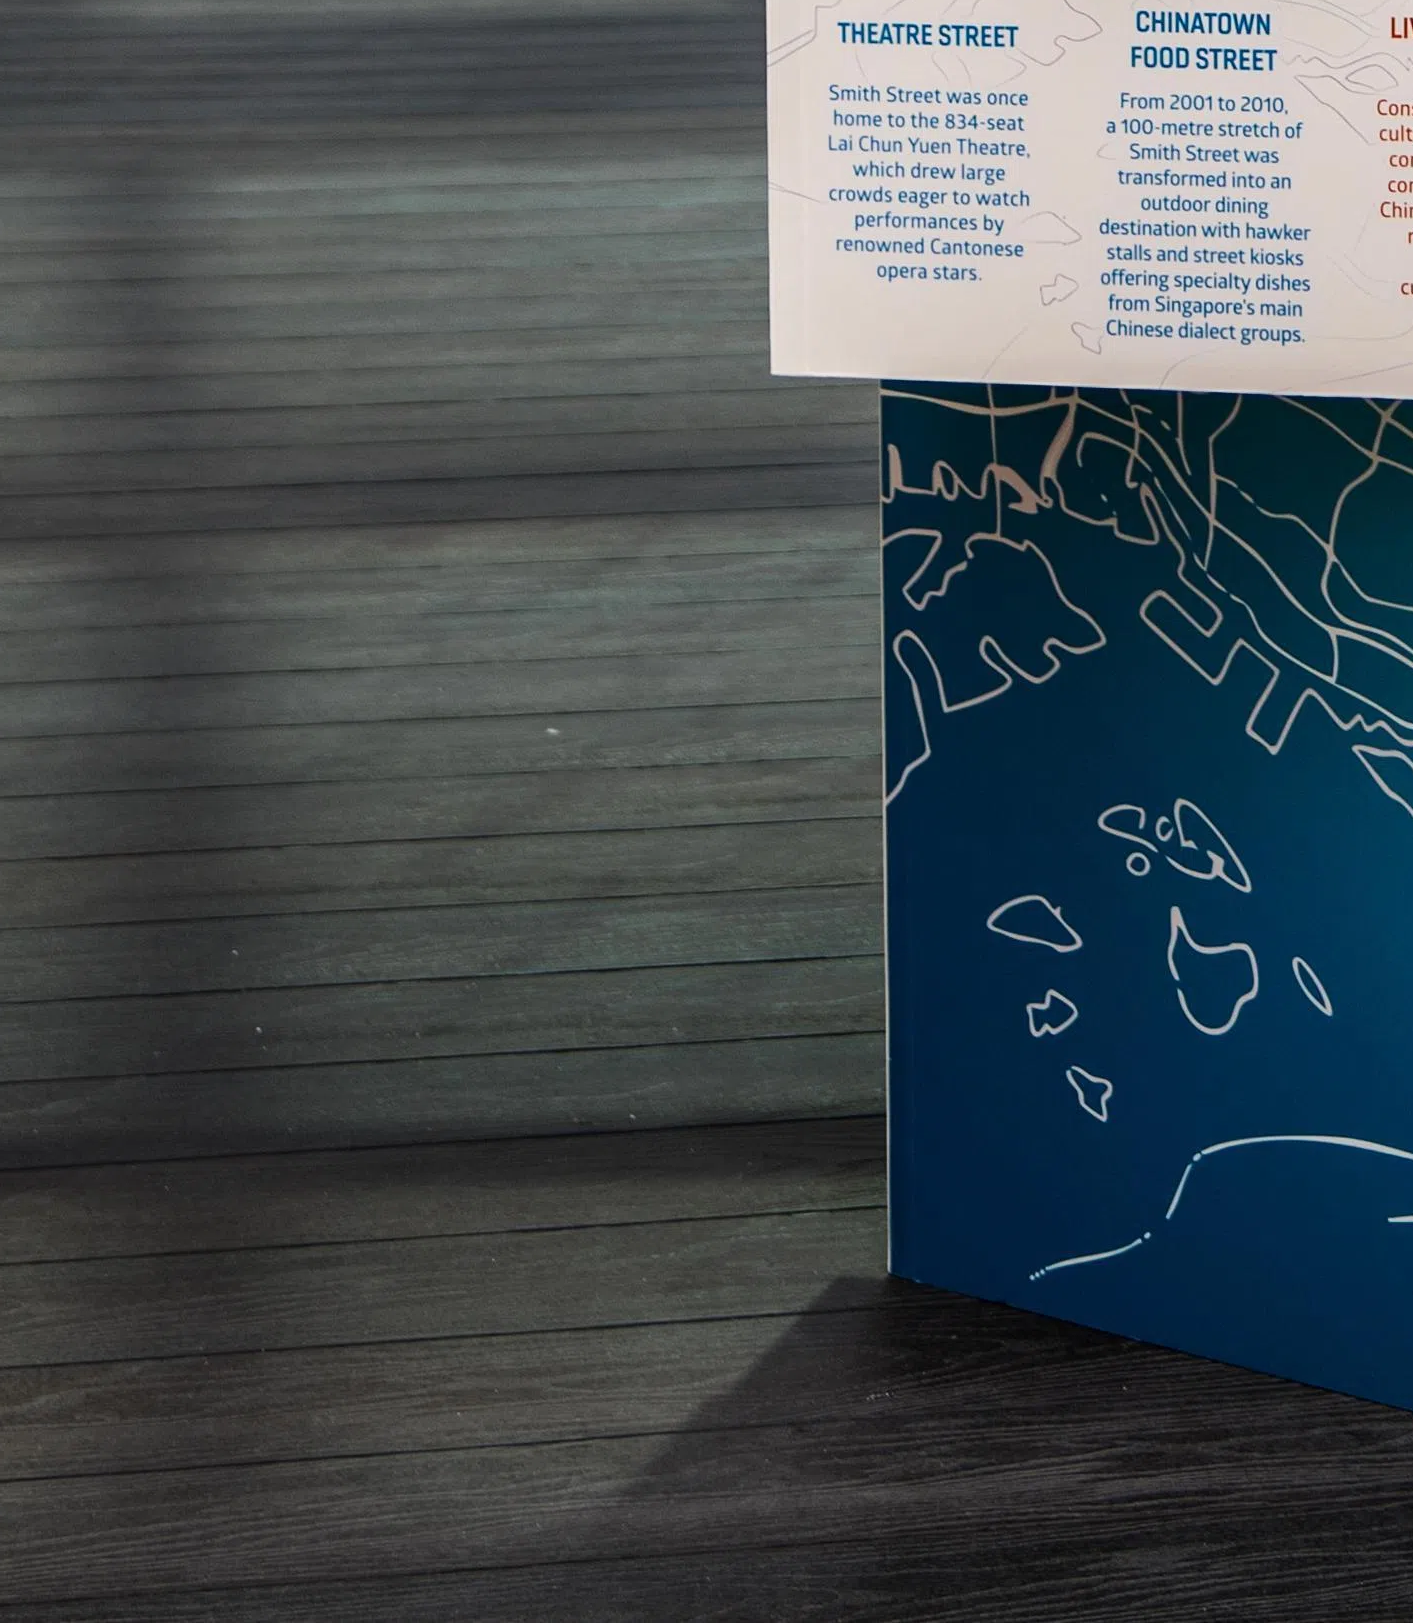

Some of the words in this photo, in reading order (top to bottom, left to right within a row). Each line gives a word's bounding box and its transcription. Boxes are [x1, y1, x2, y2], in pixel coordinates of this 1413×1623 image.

[1136, 10, 1271, 36] CHINATOWN
[837, 22, 933, 46] THEATRE
[938, 24, 1019, 48] STREET
[1131, 46, 1190, 69] FOOD
[1195, 47, 1278, 71] STREET
[829, 84, 881, 102] Smith
[886, 86, 942, 104] Street
[946, 91, 982, 105] was
[986, 92, 1029, 107] once
[1120, 92, 1165, 110] From
[1169, 94, 1213, 111] 2001
[1217, 96, 1236, 112] to
[1240, 95, 1288, 115] 2010,
[833, 109, 883, 128] home
[887, 113, 906, 128] to
[910, 111, 940, 129] the
[944, 113, 1025, 132] 834-seat
[1106, 120, 1116, 134] a
[1121, 118, 1214, 137] 100-metre
[1218, 121, 1280, 138] stretch
[1284, 121, 1304, 139] of
[828, 135, 853, 152] Lai
[858, 135, 903, 153] Chun
[907, 136, 952, 155] Yuen
[956, 138, 1031, 158] Theatre,
